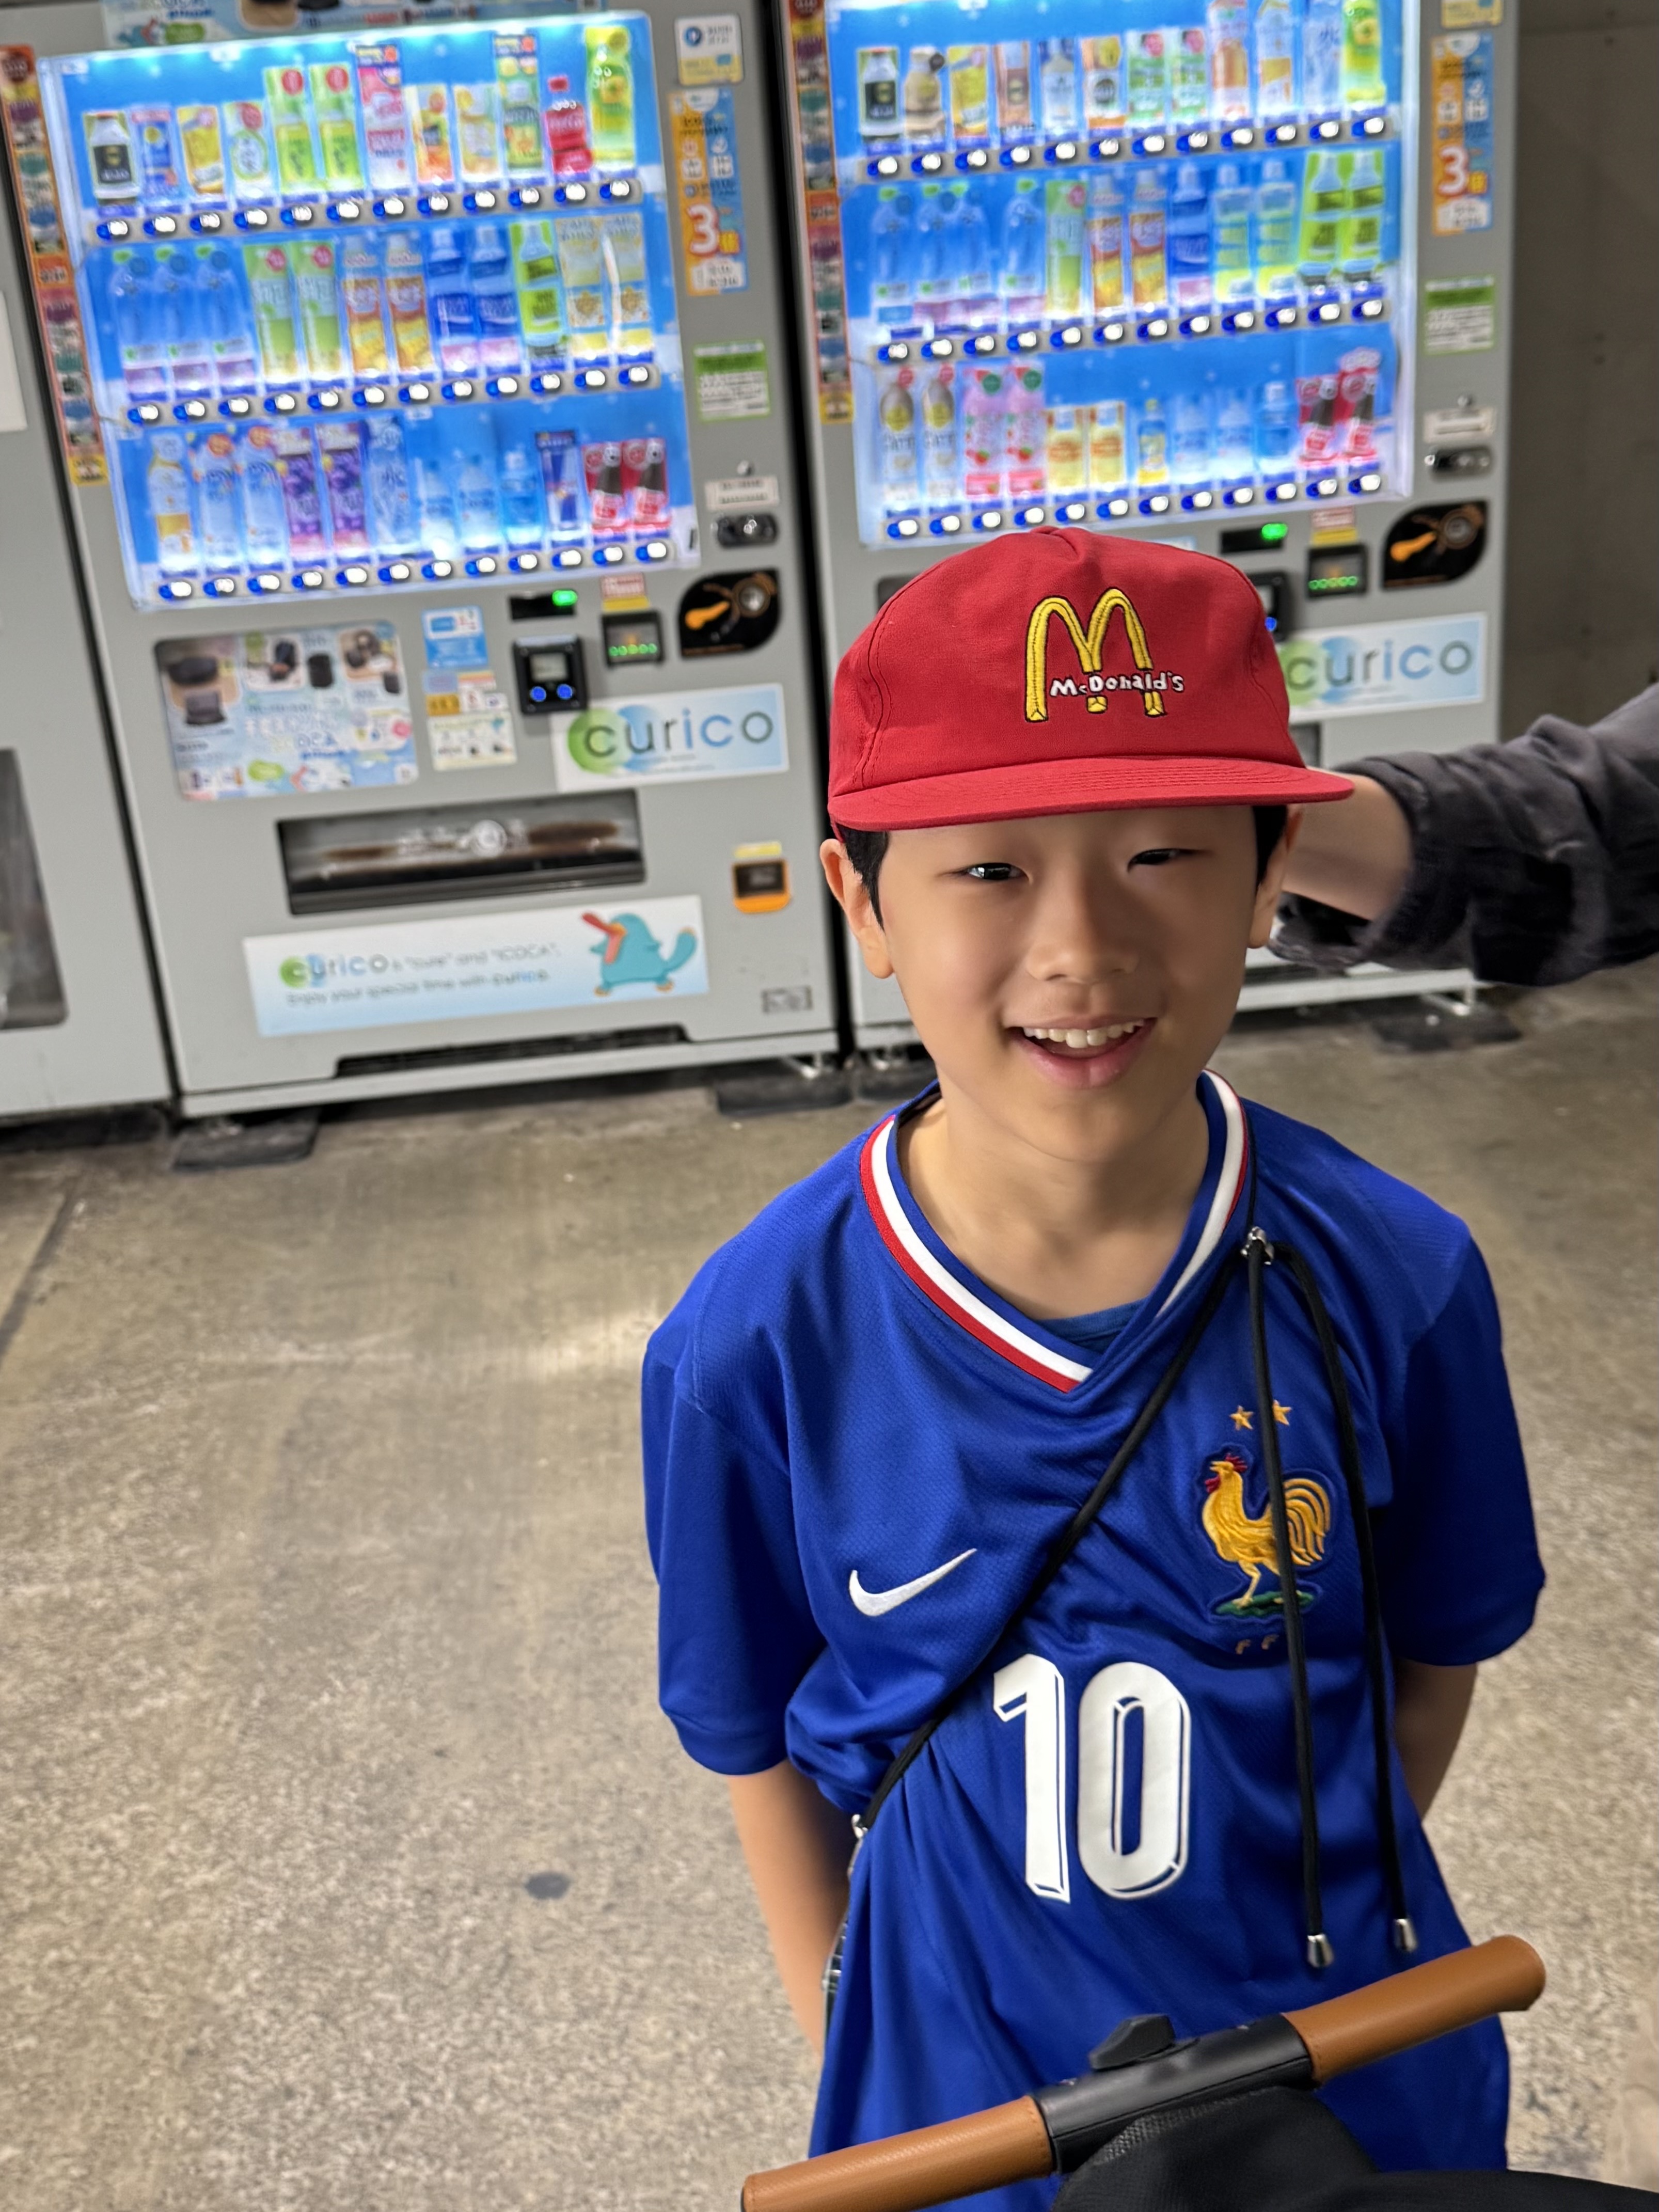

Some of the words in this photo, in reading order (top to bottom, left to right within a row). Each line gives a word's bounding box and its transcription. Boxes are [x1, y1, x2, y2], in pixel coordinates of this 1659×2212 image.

[686, 203, 720, 258] 3
[1049, 671, 1184, 698] McDonald's
[1286, 639, 1474, 690] curico
[584, 707, 773, 757] curico
[992, 1652, 1190, 1904] 10
